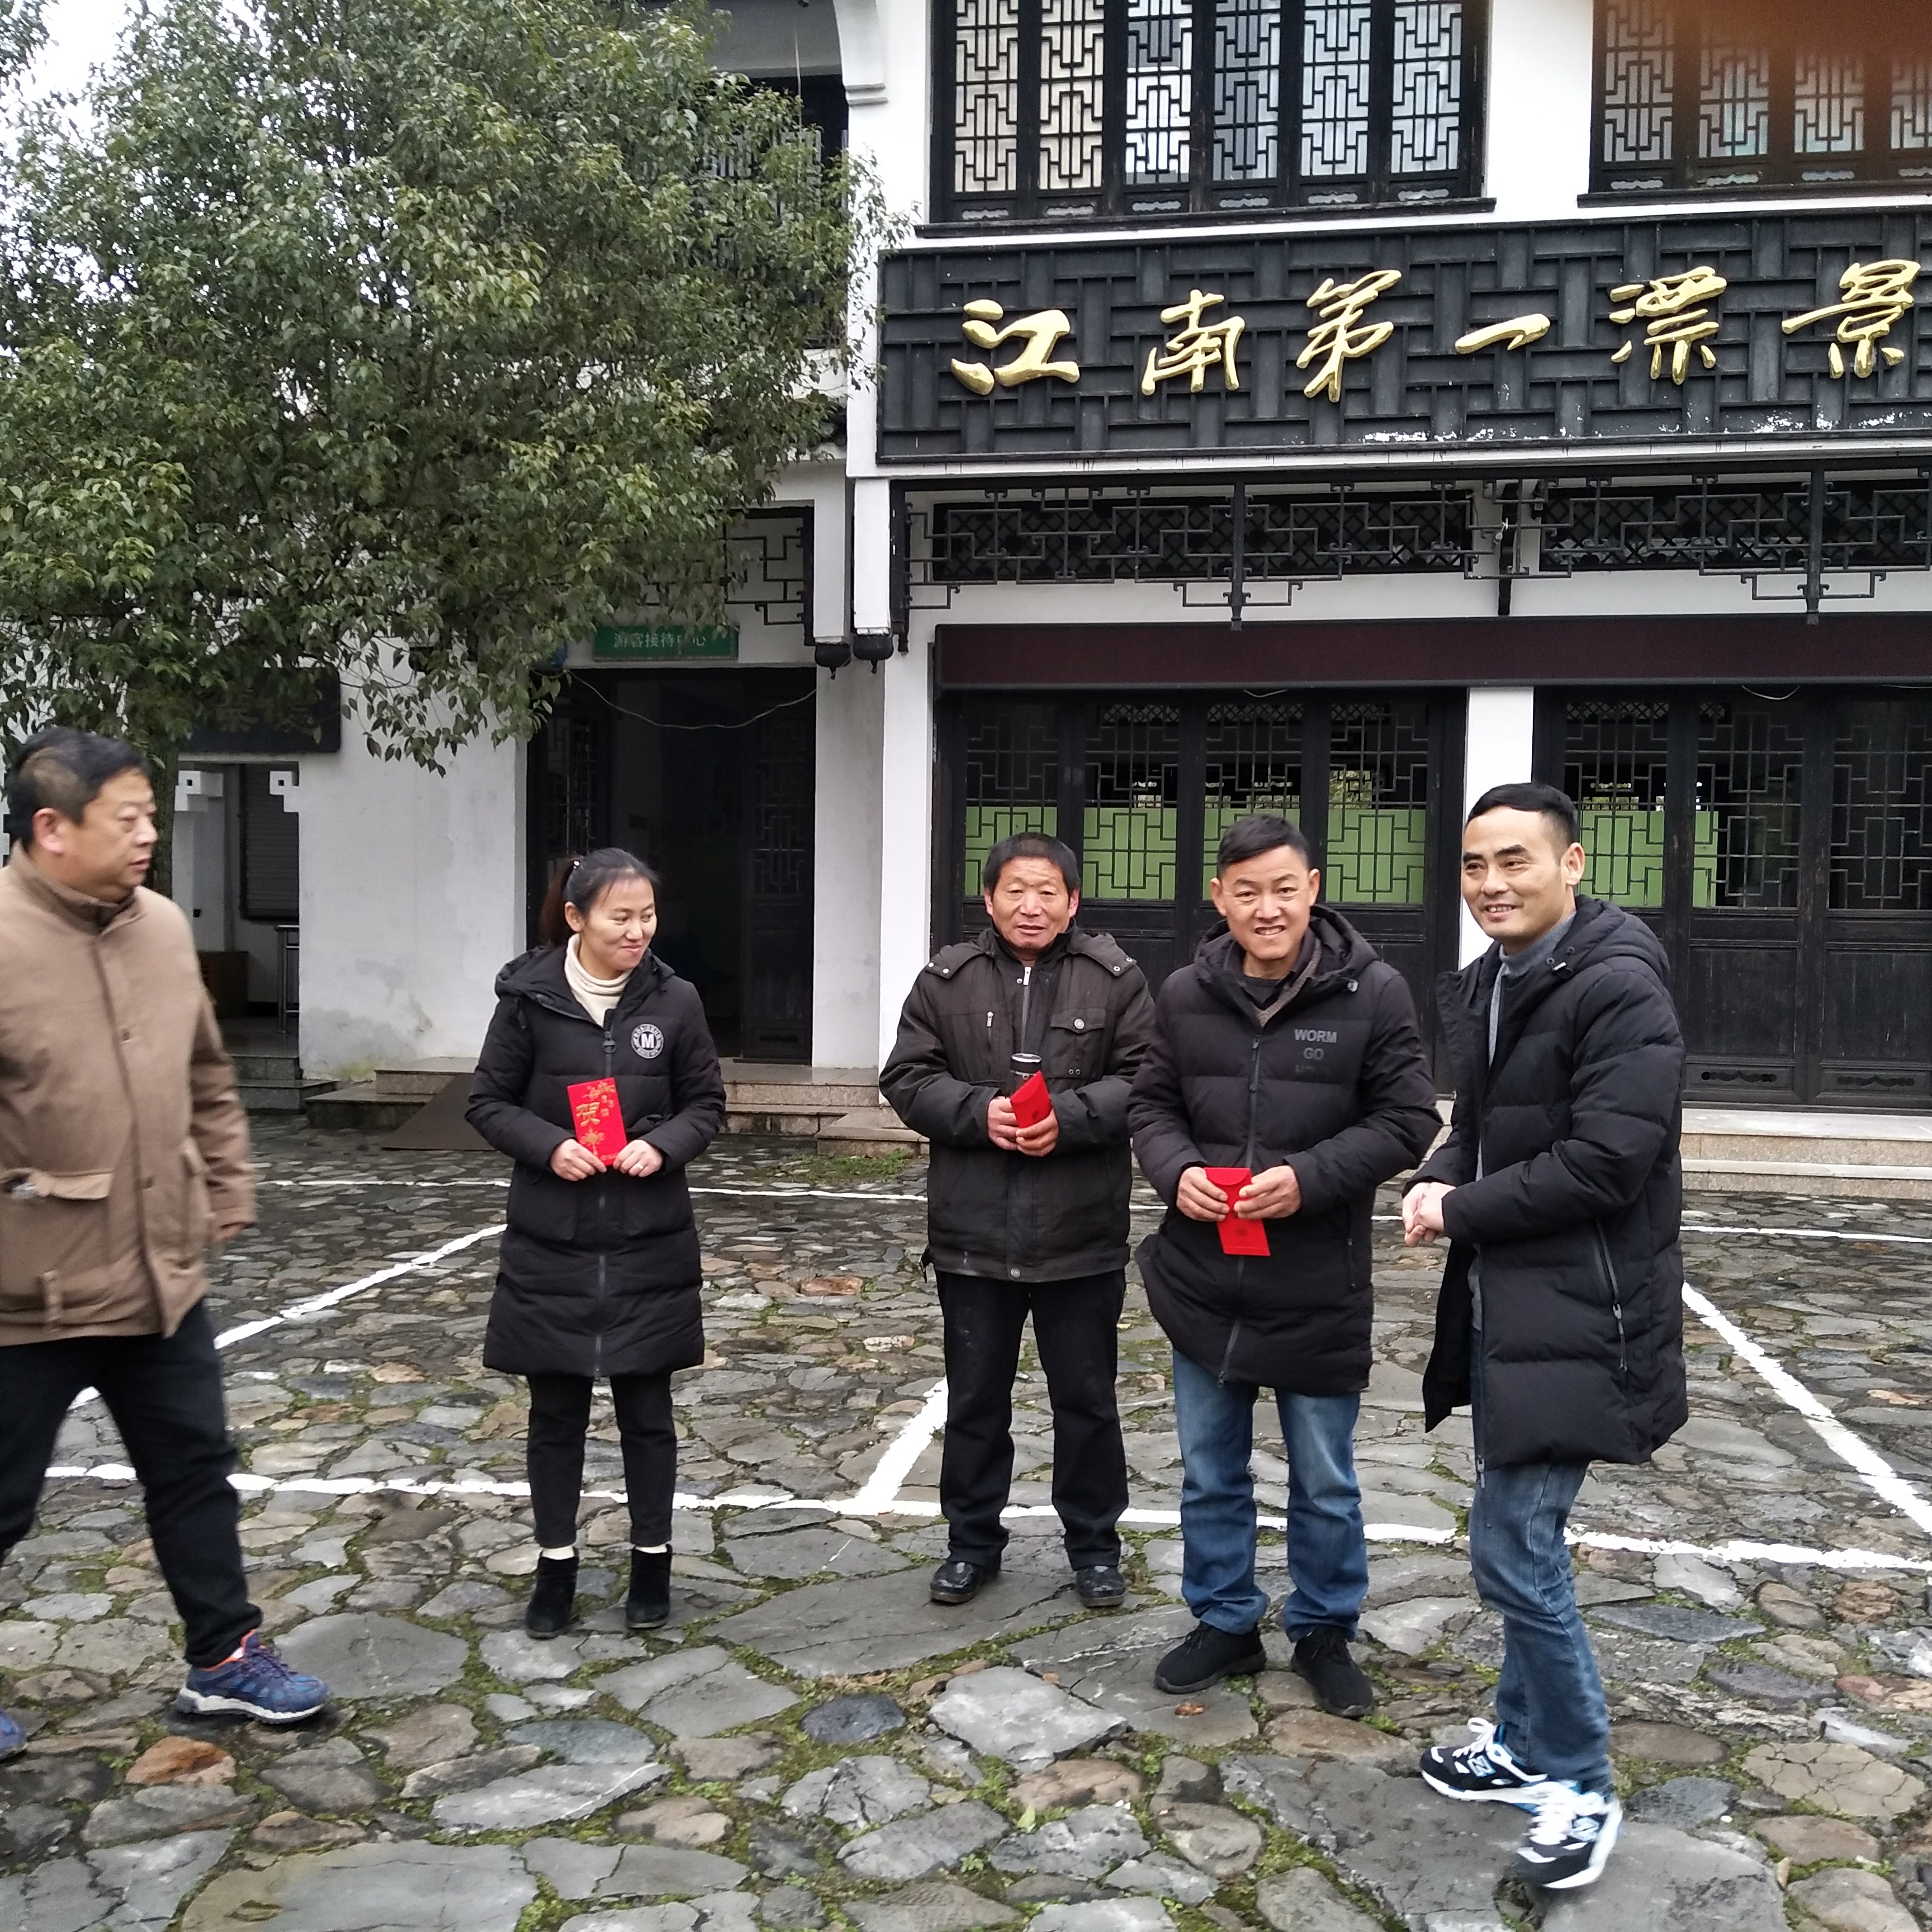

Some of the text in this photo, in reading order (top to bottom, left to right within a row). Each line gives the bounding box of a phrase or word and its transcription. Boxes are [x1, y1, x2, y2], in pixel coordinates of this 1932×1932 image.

[641, 1033, 654, 1048] M
[1294, 1029, 1337, 1043] WORM
[1303, 1047, 1324, 1060] GO
